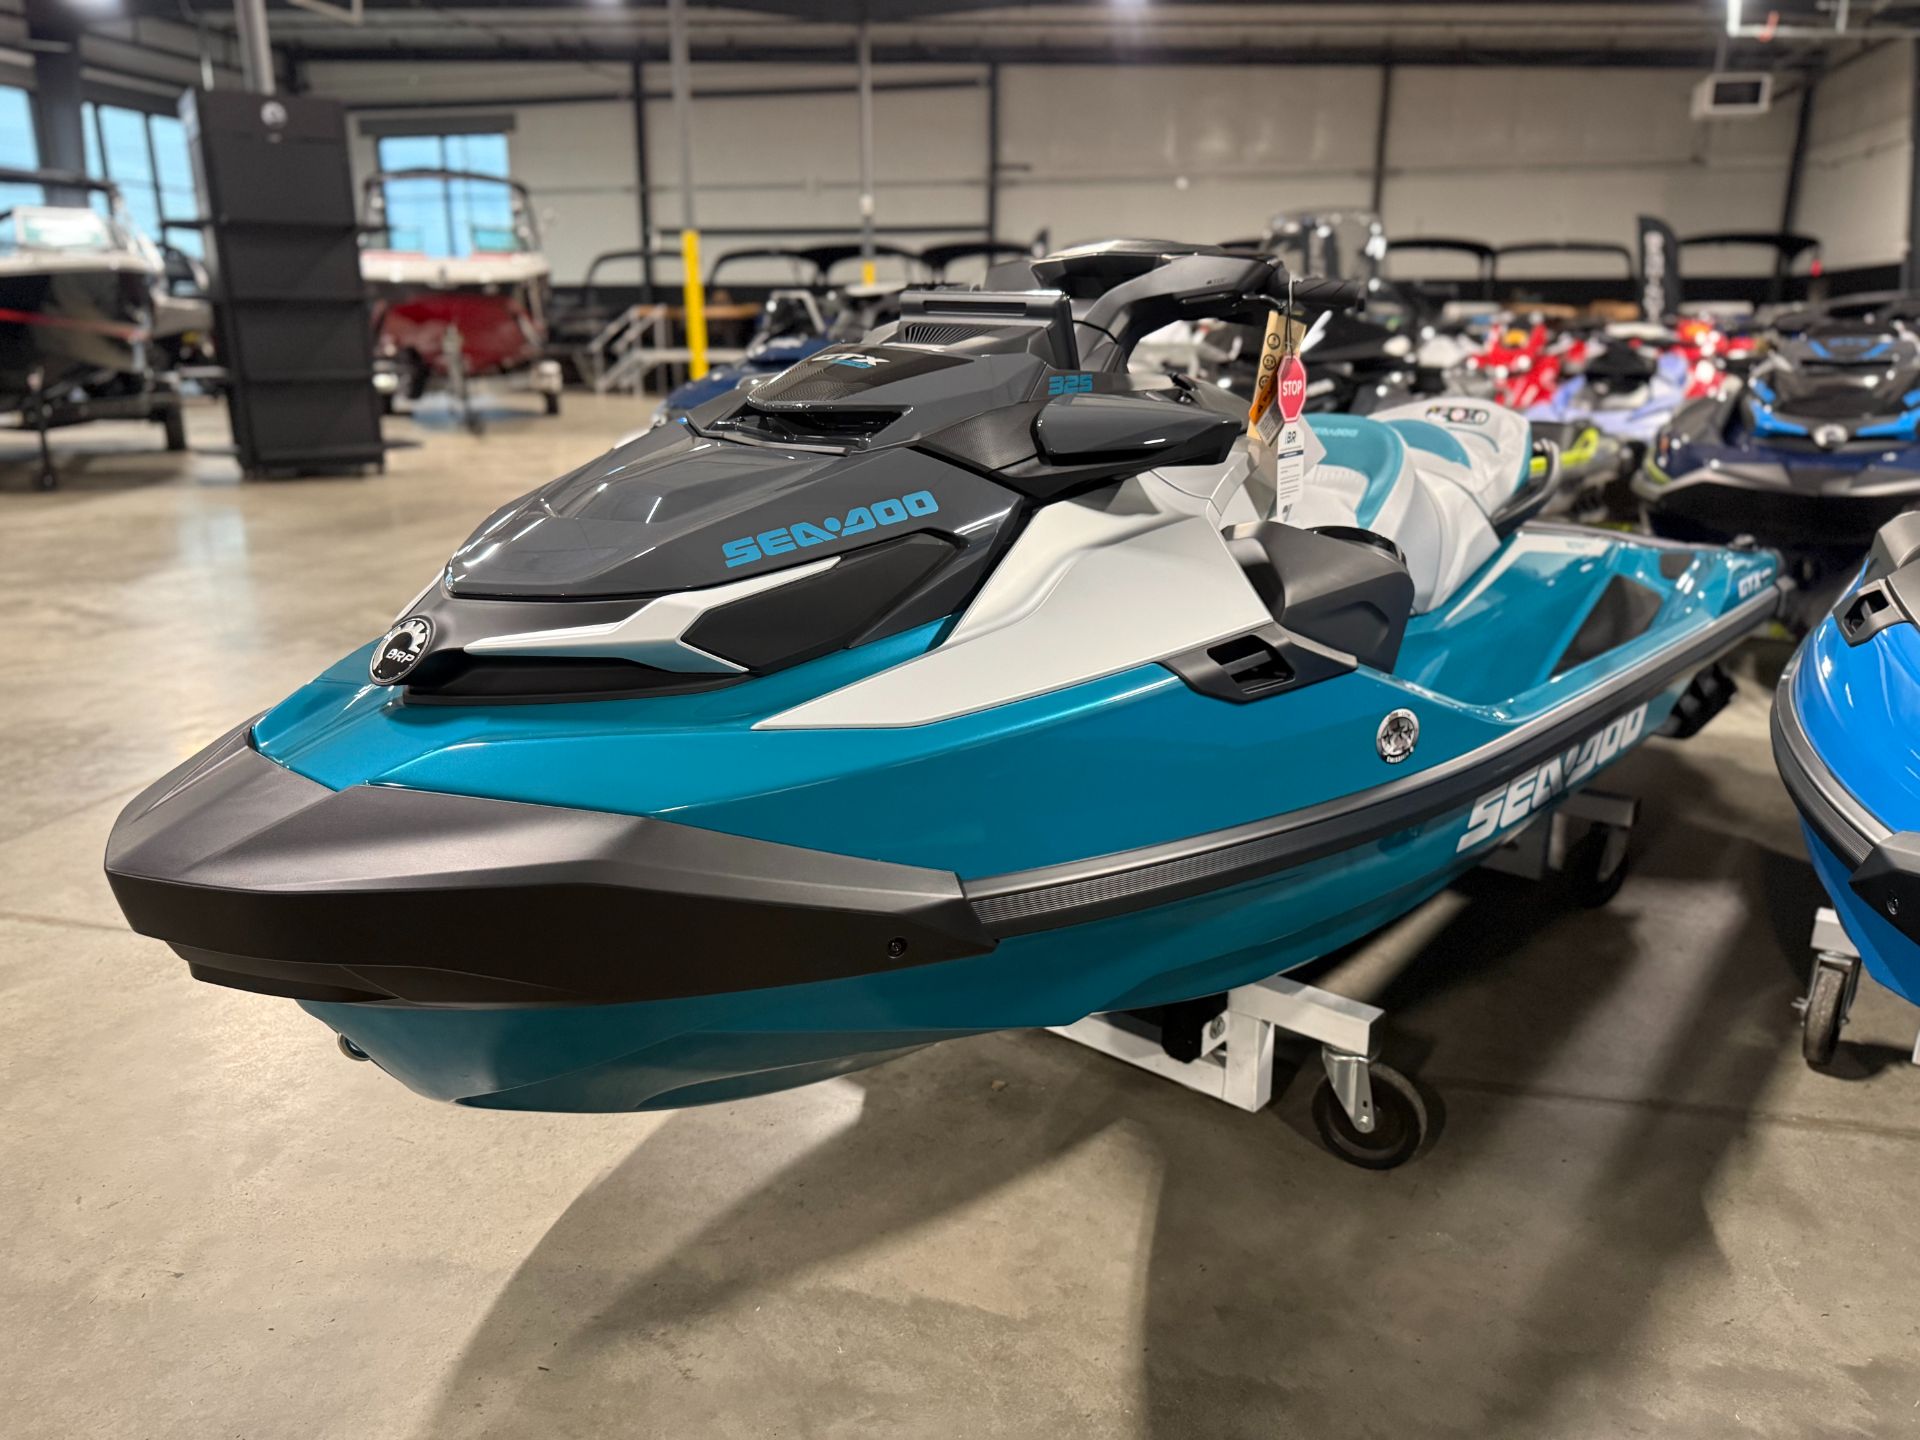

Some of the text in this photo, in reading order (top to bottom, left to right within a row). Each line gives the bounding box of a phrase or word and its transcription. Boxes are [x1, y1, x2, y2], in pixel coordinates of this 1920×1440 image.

[1048, 374, 1093, 395] 325
[1282, 381, 1303, 397] STOP
[385, 648, 415, 663] BRP
